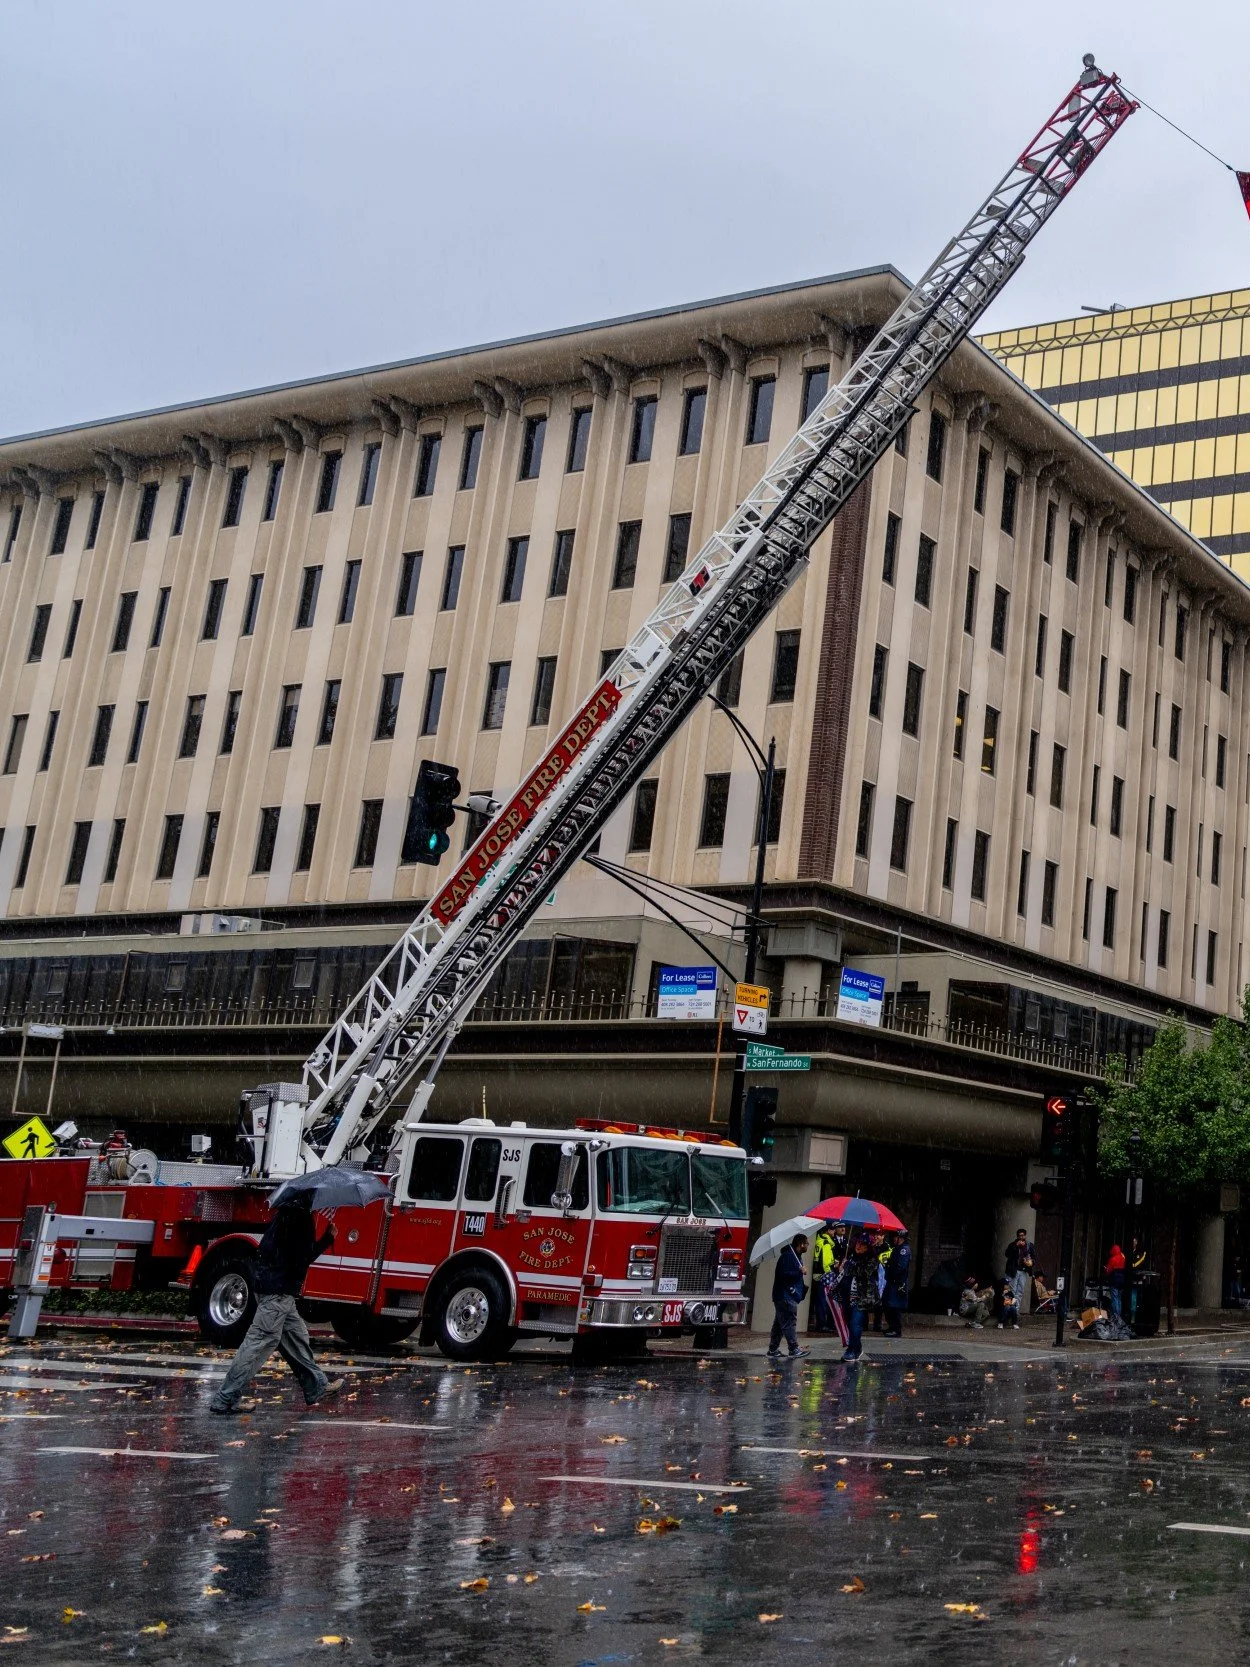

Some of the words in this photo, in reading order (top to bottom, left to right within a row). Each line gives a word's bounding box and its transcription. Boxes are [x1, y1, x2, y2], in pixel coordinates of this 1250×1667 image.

[439, 871, 476, 916] SAN
[478, 808, 523, 870] JOSE
[521, 755, 565, 810] FIRE
[562, 691, 617, 756] DEPT.
[662, 974, 674, 982] For
[675, 974, 696, 982] Lease
[843, 975, 853, 983] For
[853, 977, 869, 988] Lease
[678, 986, 694, 994] Space
[739, 986, 758, 996] TURNING
[737, 995, 758, 1004] VEHICLES
[752, 1045, 776, 1056] Market
[502, 1149, 521, 1162] SJS
[464, 1216, 485, 1233] T440
[523, 1227, 545, 1241] SAN
[548, 1227, 575, 1244] JOSE
[519, 1250, 541, 1268] FIRE
[544, 1255, 574, 1269] DEPT.
[527, 1289, 572, 1302] PARAMEDIC
[664, 1304, 682, 1322] SJS
